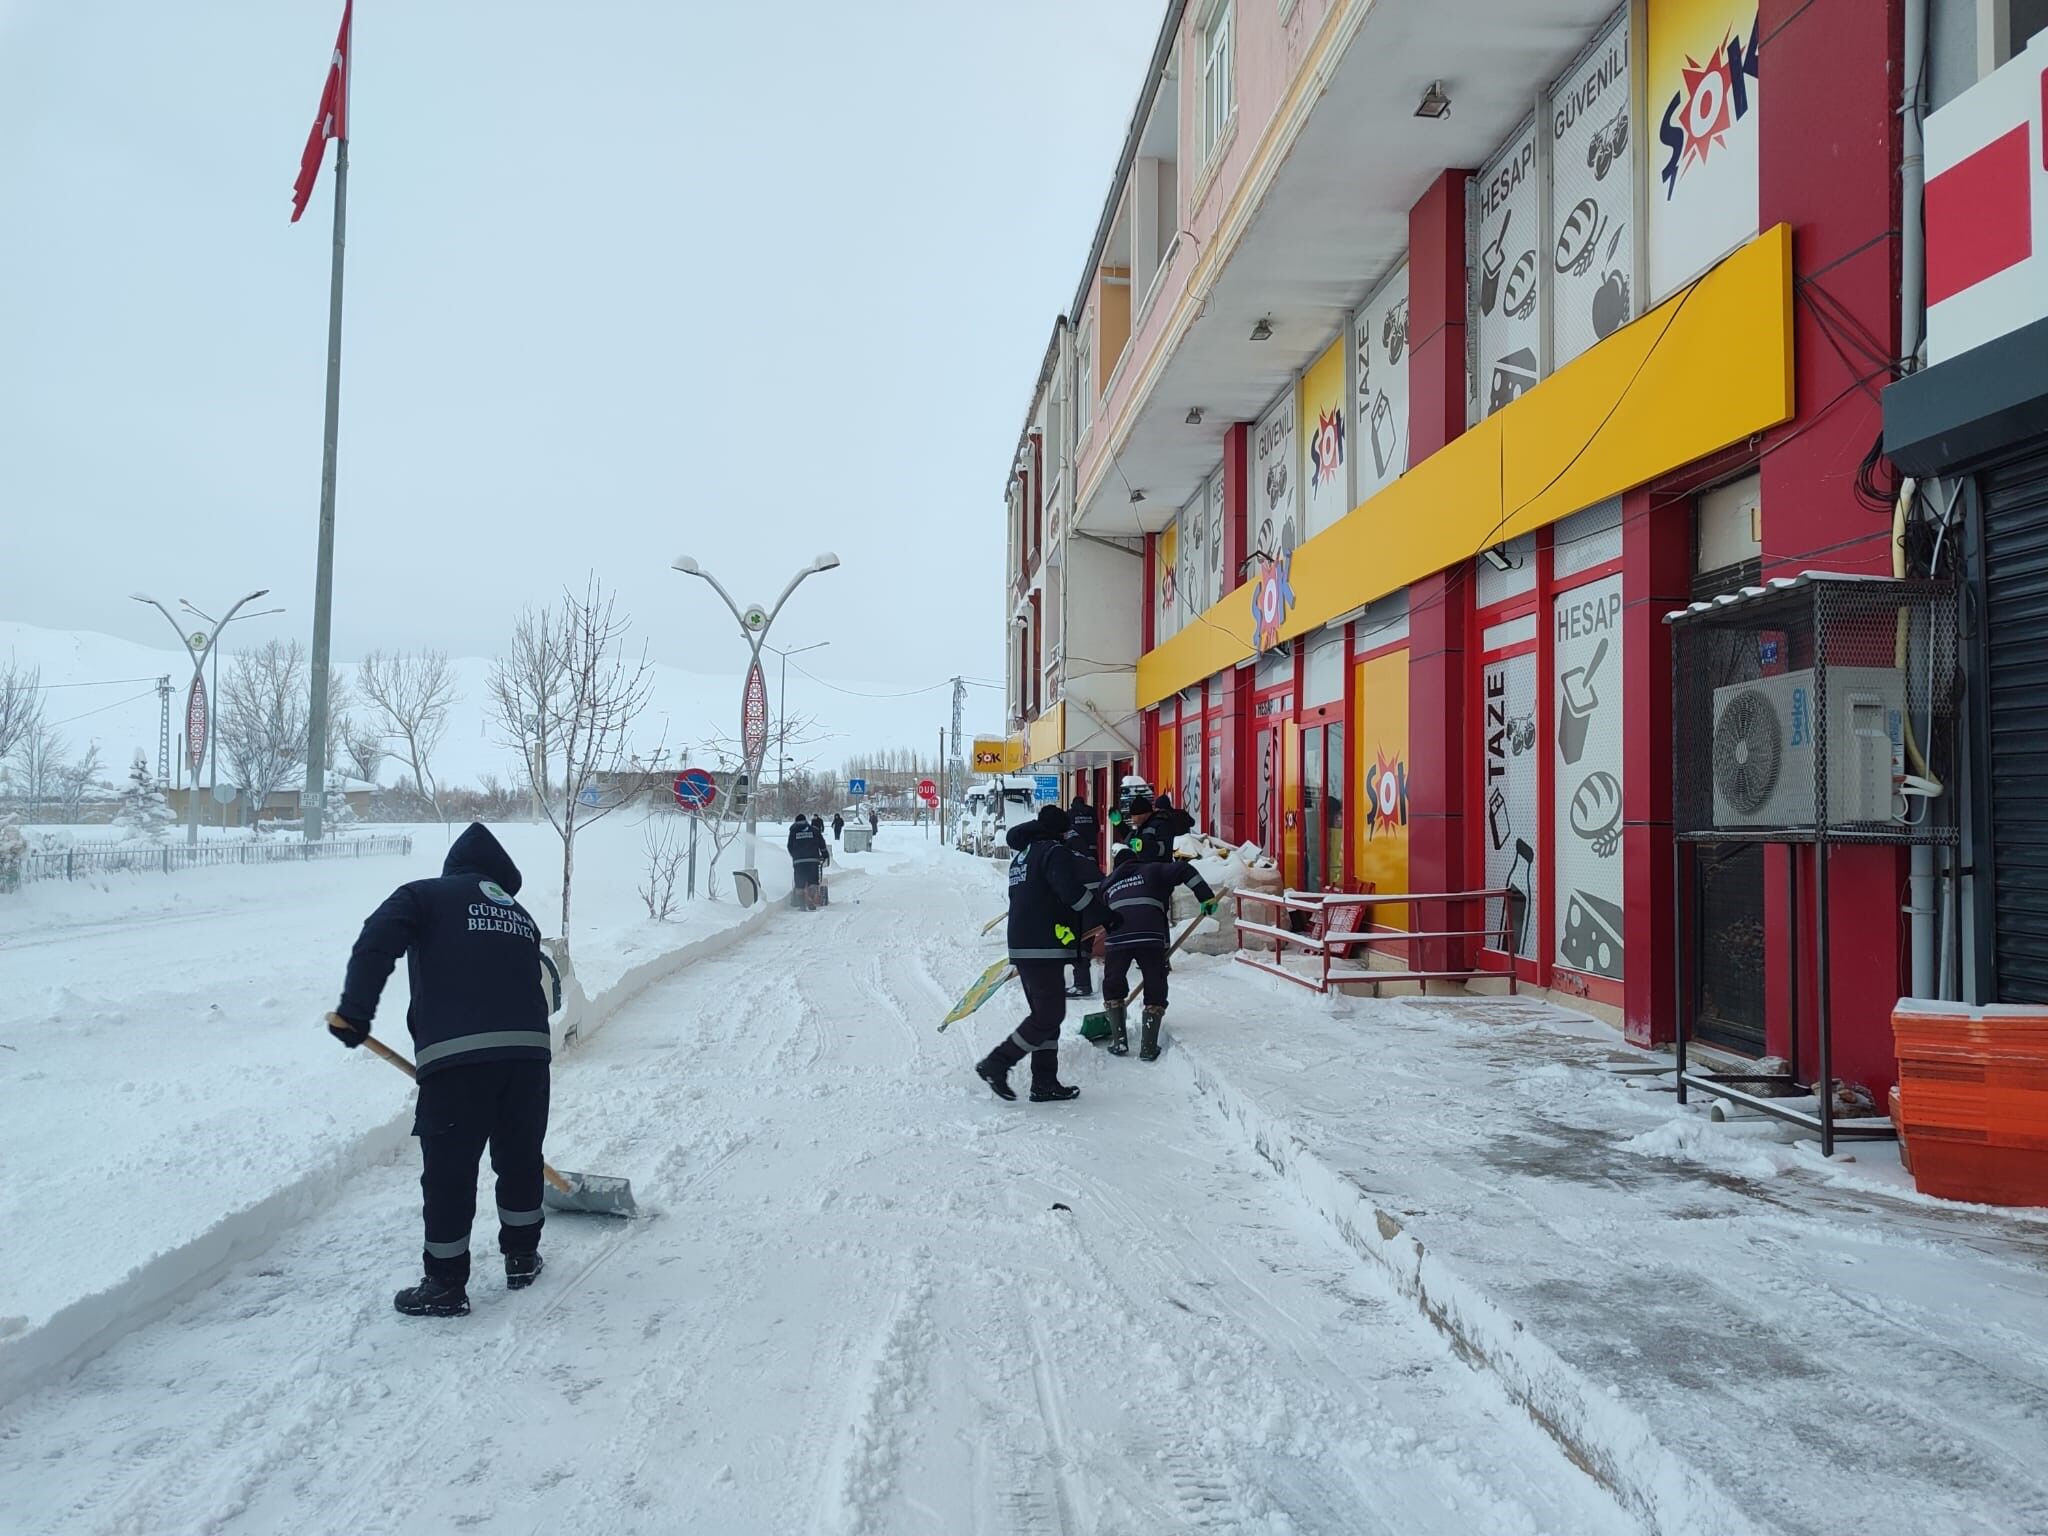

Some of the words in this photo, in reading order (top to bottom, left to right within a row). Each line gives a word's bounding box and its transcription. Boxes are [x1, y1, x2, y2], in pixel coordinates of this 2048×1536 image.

[1554, 31, 1628, 140] GÜVENİLİ
[1358, 319, 1370, 423] TAZE
[1251, 549, 1296, 657] ŞOK
[1557, 592, 1621, 643] HESAP
[976, 752, 1002, 766] ŞOK
[1487, 671, 1505, 786] TAZE
[918, 785, 936, 794] DUR
